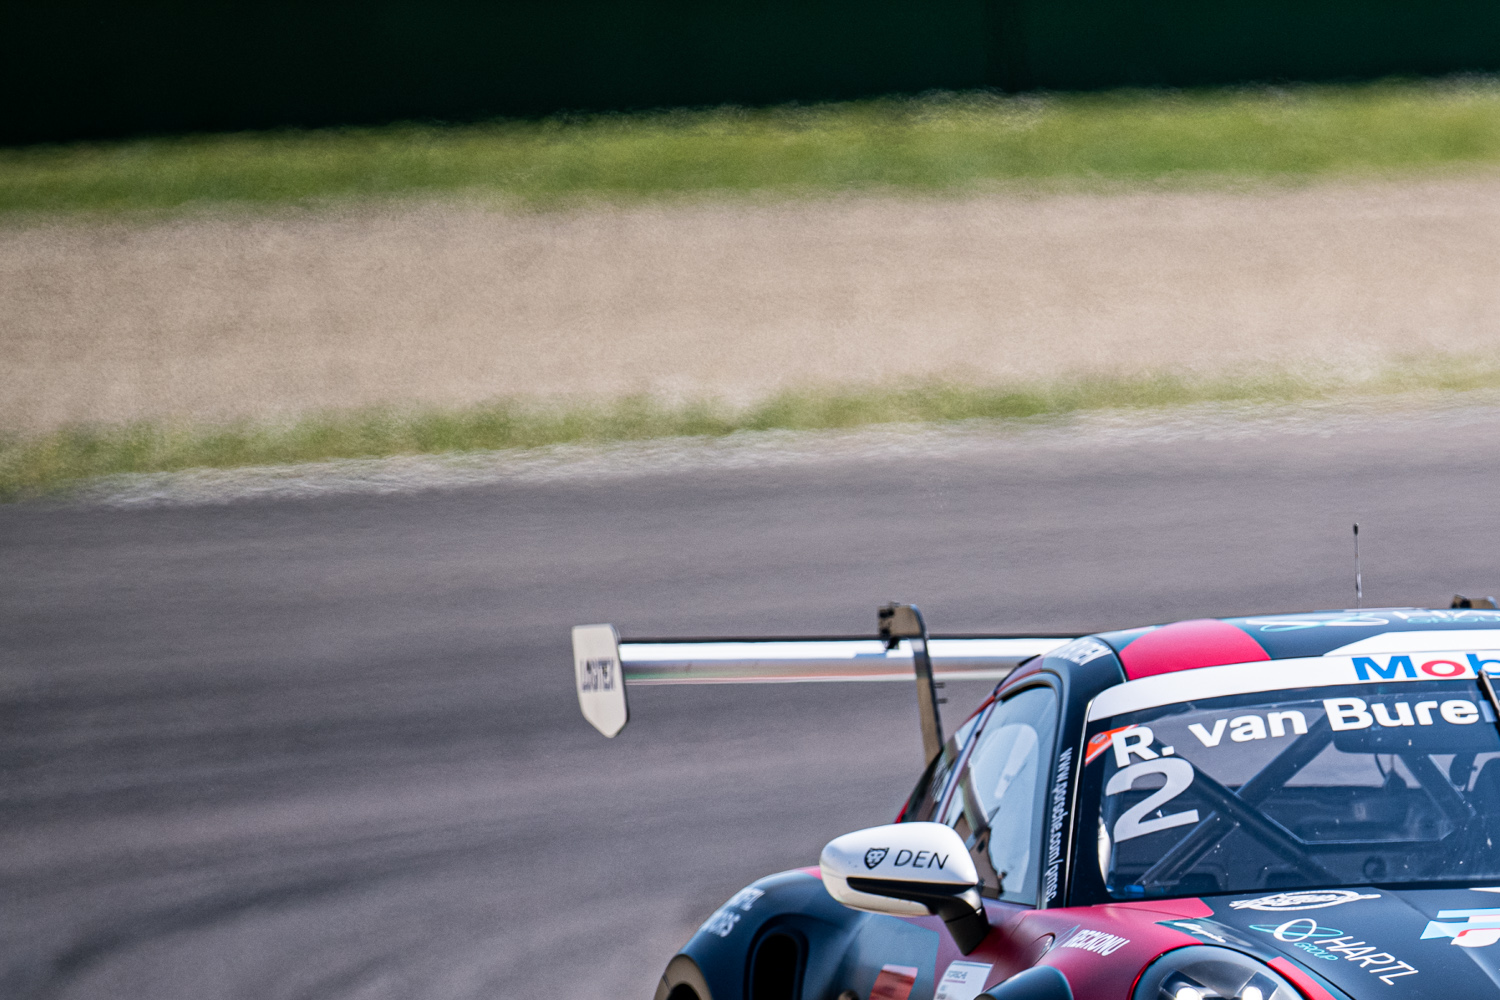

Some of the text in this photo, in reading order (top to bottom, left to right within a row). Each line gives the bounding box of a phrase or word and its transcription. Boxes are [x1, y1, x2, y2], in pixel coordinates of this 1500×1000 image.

[1112, 725, 1174, 769] R.
[1188, 709, 1309, 748] van
[1105, 757, 1200, 843] 2
[893, 849, 950, 870] DEN
[1293, 941, 1339, 961] GROUP
[1313, 935, 1419, 986] HARTL
